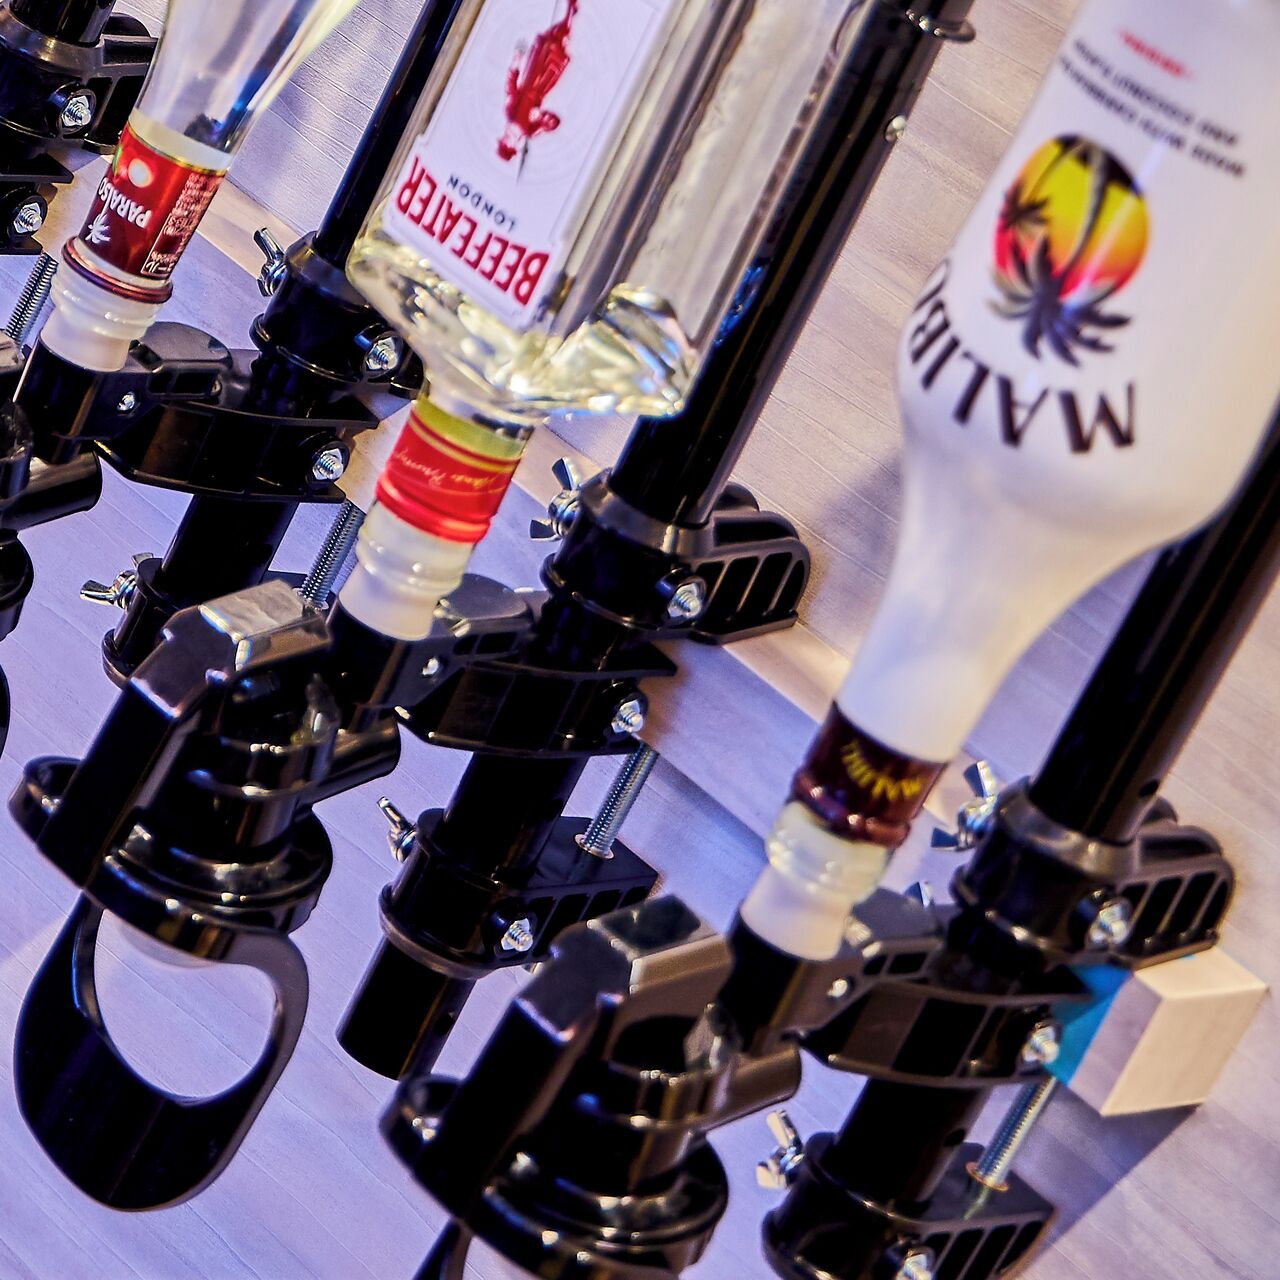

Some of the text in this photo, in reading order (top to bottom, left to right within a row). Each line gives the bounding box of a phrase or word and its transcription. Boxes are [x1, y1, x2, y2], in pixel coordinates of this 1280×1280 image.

[96, 175, 152, 228] PARAISO
[395, 155, 549, 306] BEEFEATER
[444, 174, 516, 233] LONDON
